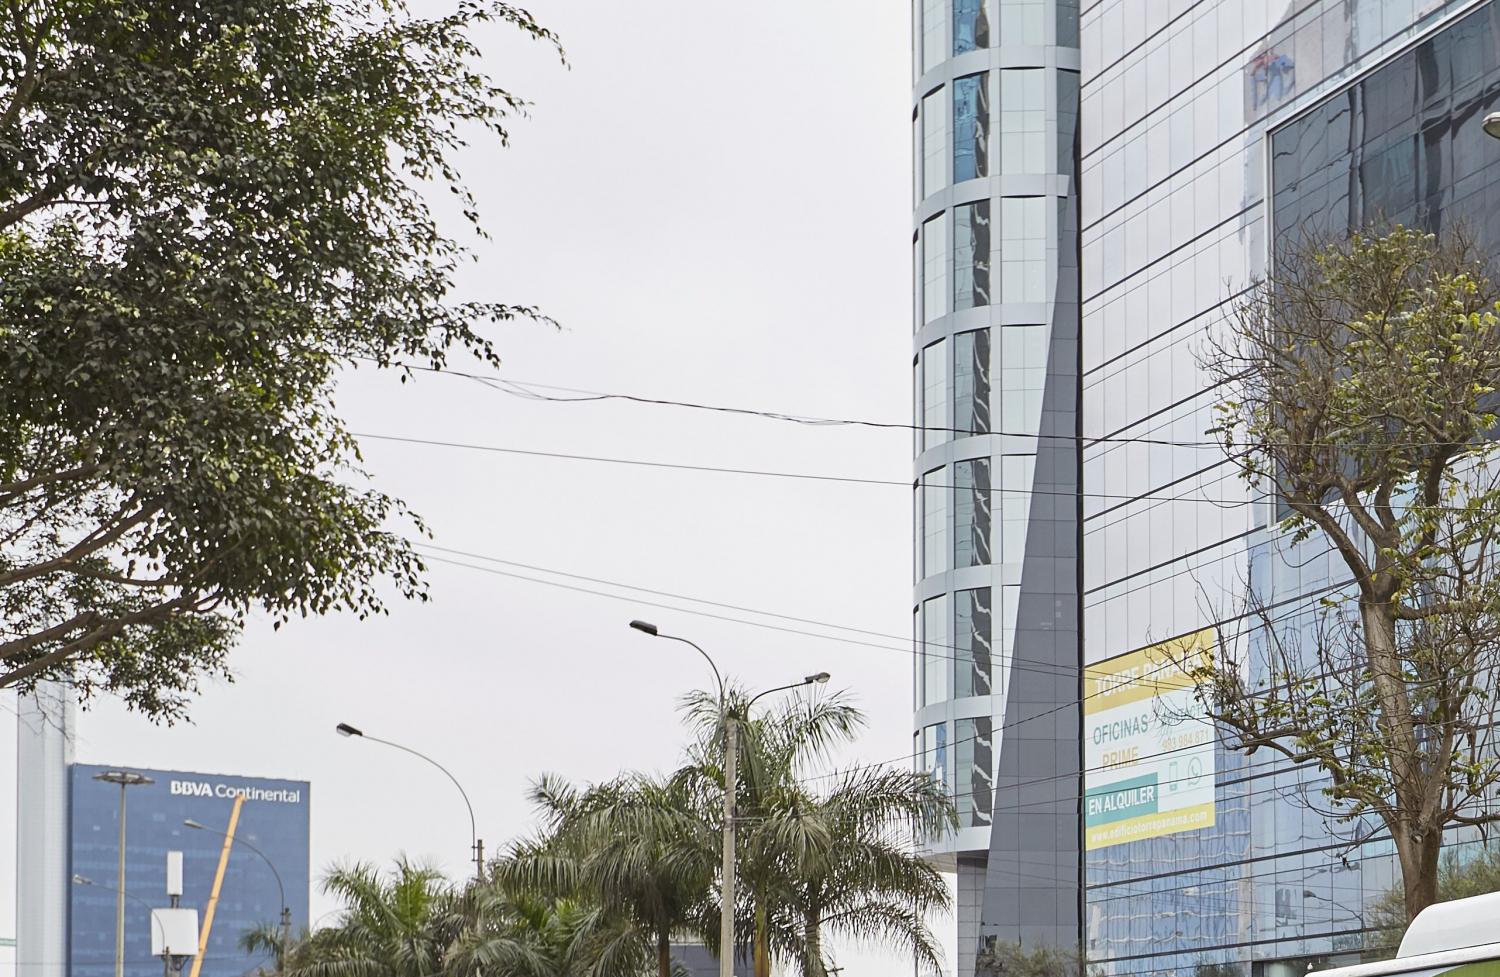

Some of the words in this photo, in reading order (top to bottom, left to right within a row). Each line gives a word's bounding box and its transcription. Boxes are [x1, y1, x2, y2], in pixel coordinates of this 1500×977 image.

[1093, 716, 1149, 746] OFICINAS
[1102, 747, 1139, 773] PRIME
[170, 780, 213, 797] BBVA
[215, 784, 301, 803] Continental
[1088, 796, 1103, 817] EN
[1104, 787, 1155, 813] ALQUILER
